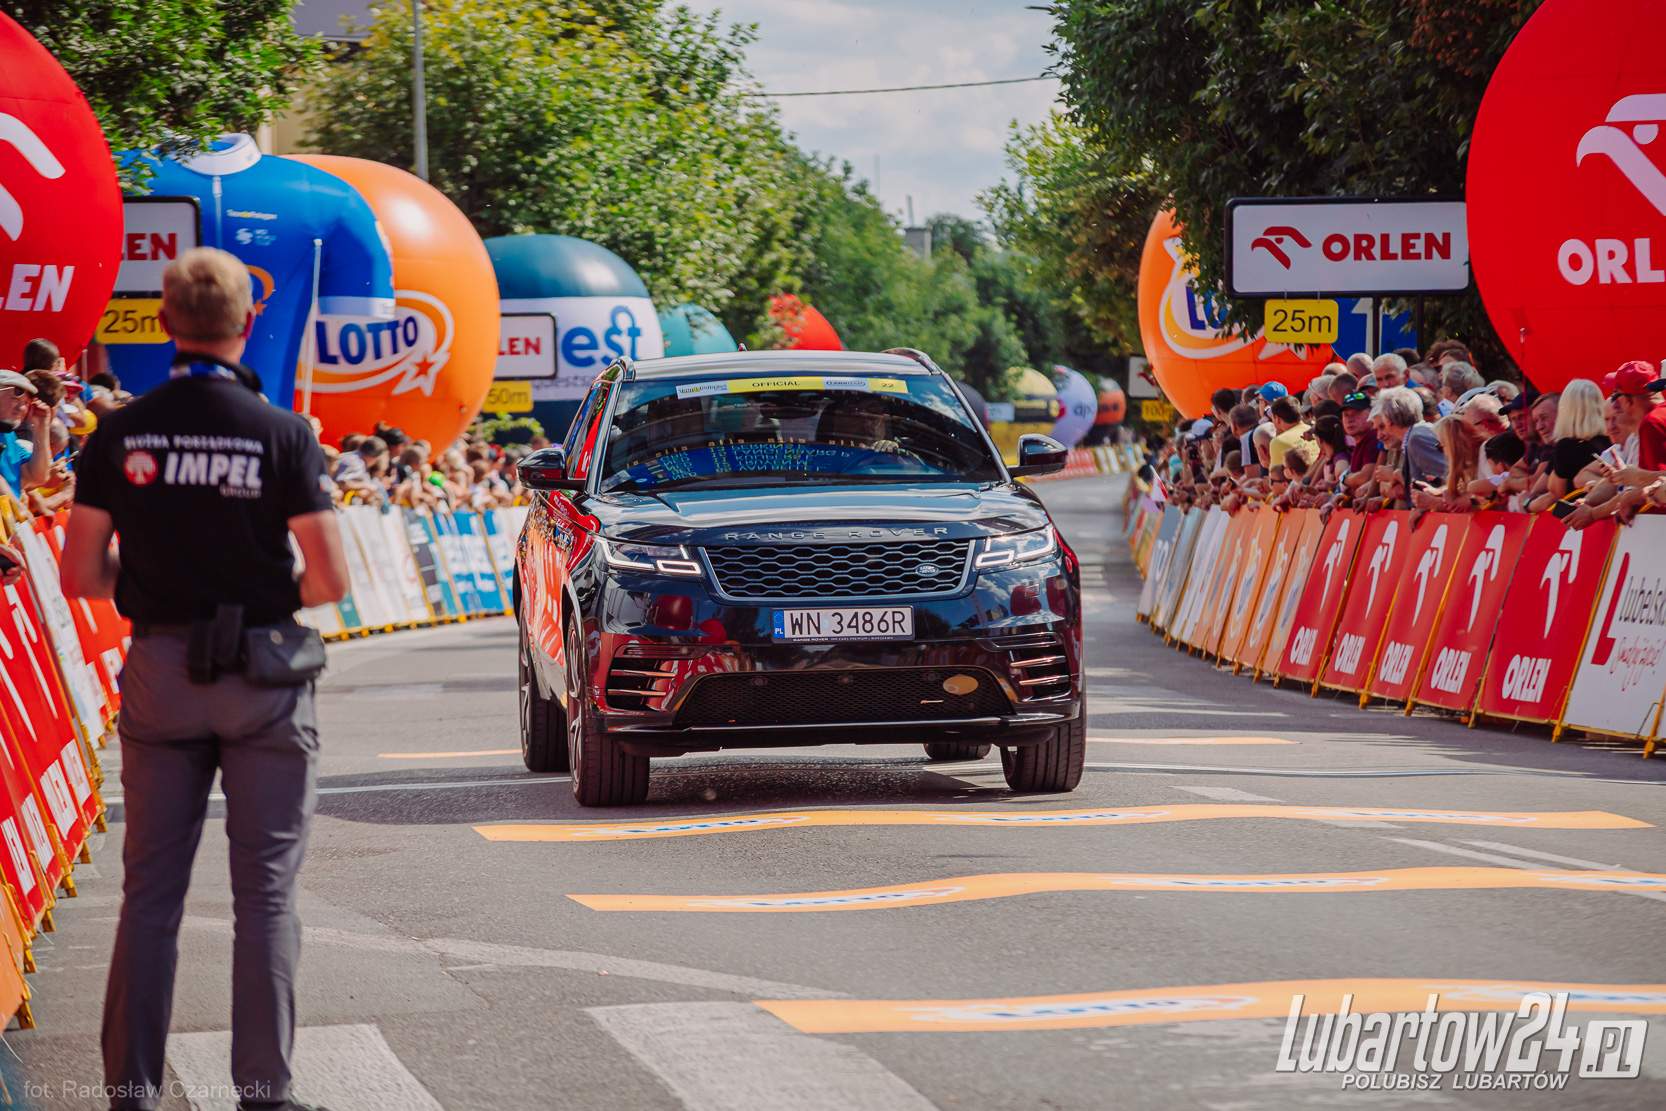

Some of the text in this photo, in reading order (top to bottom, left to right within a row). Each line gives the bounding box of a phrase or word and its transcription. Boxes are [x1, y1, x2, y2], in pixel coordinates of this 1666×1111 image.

[122, 232, 177, 261] EN
[1322, 231, 1451, 262] ORLEN
[1557, 237, 1665, 286] ORL
[0, 263, 75, 312] EN
[1272, 309, 1332, 333] 25m
[315, 316, 418, 365] LOTTO
[488, 387, 529, 405] 50m
[164, 452, 262, 489] IMPEL
[725, 527, 948, 541] RANGE ROVER
[775, 627, 784, 635] PL
[790, 610, 906, 635] WN 3486R
[1430, 645, 1473, 695] ORLEN
[1502, 654, 1553, 704] ORLEN
